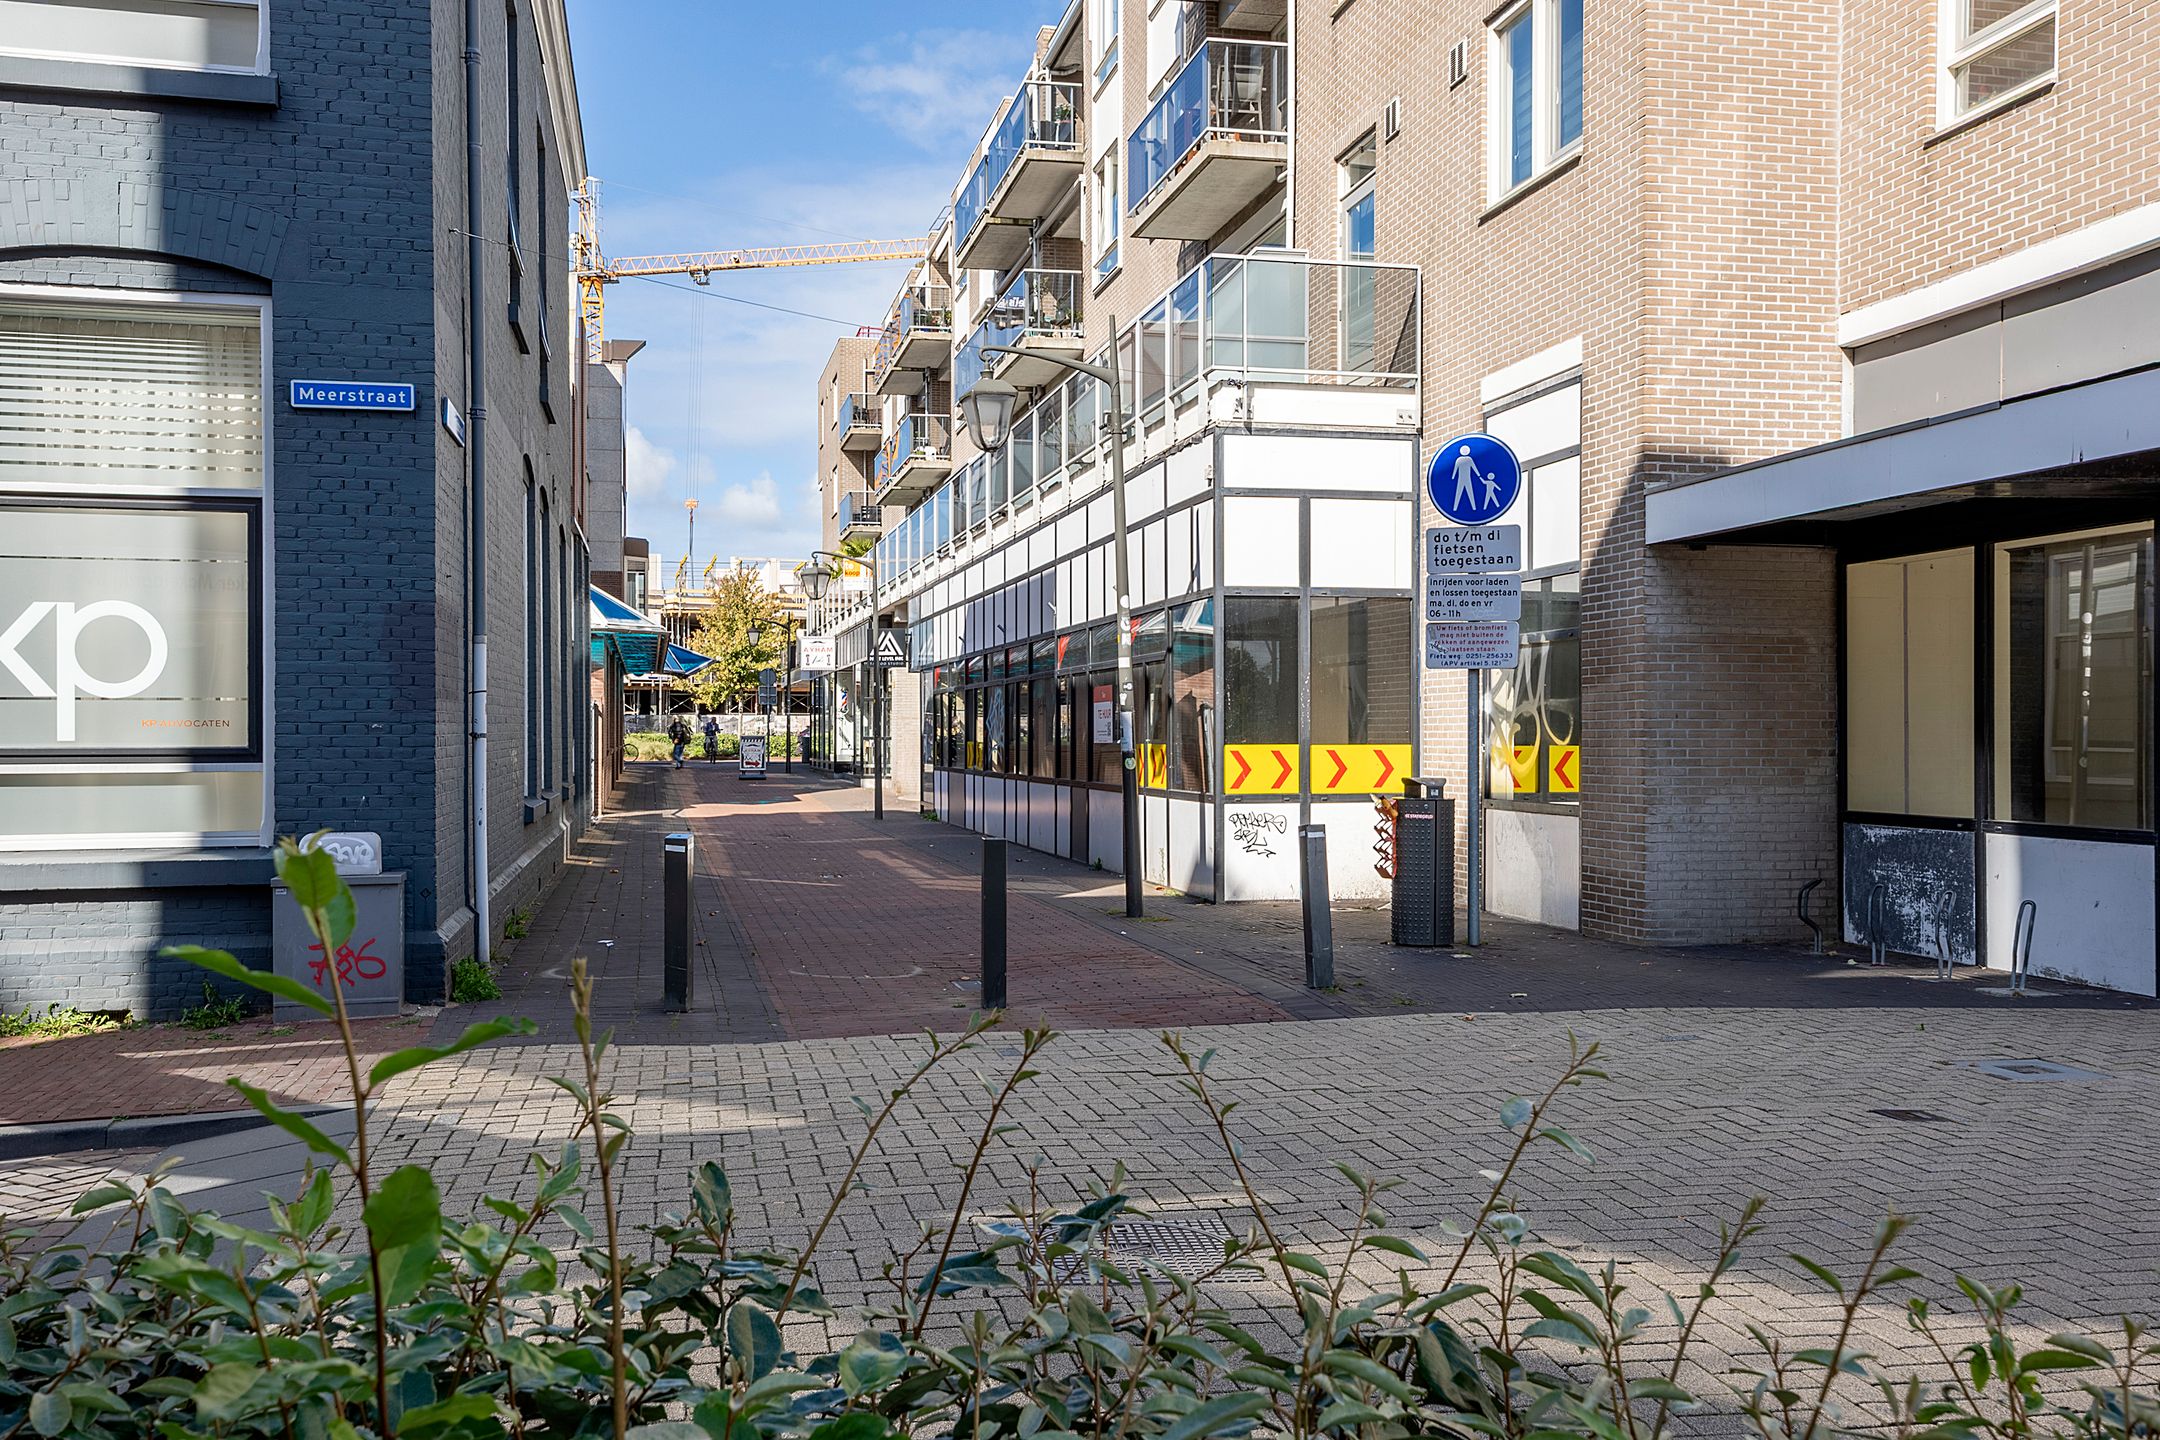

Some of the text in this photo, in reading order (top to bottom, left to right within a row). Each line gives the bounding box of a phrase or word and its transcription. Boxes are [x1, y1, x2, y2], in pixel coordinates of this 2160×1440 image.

[299, 387, 406, 404] Meerstraat
[1434, 530, 1500, 543] do t/m di
[1434, 544, 1484, 555] fietsen
[1434, 555, 1514, 569] toegestaan
[1429, 578, 1463, 588] Inrijden
[1485, 578, 1509, 586] laden
[1442, 589, 1469, 597] lossen
[1471, 589, 1518, 598] toegestaan
[1459, 599, 1469, 607] do
[1429, 610, 1441, 618] 06
[141, 719, 230, 728] KP ADVOCATEN
